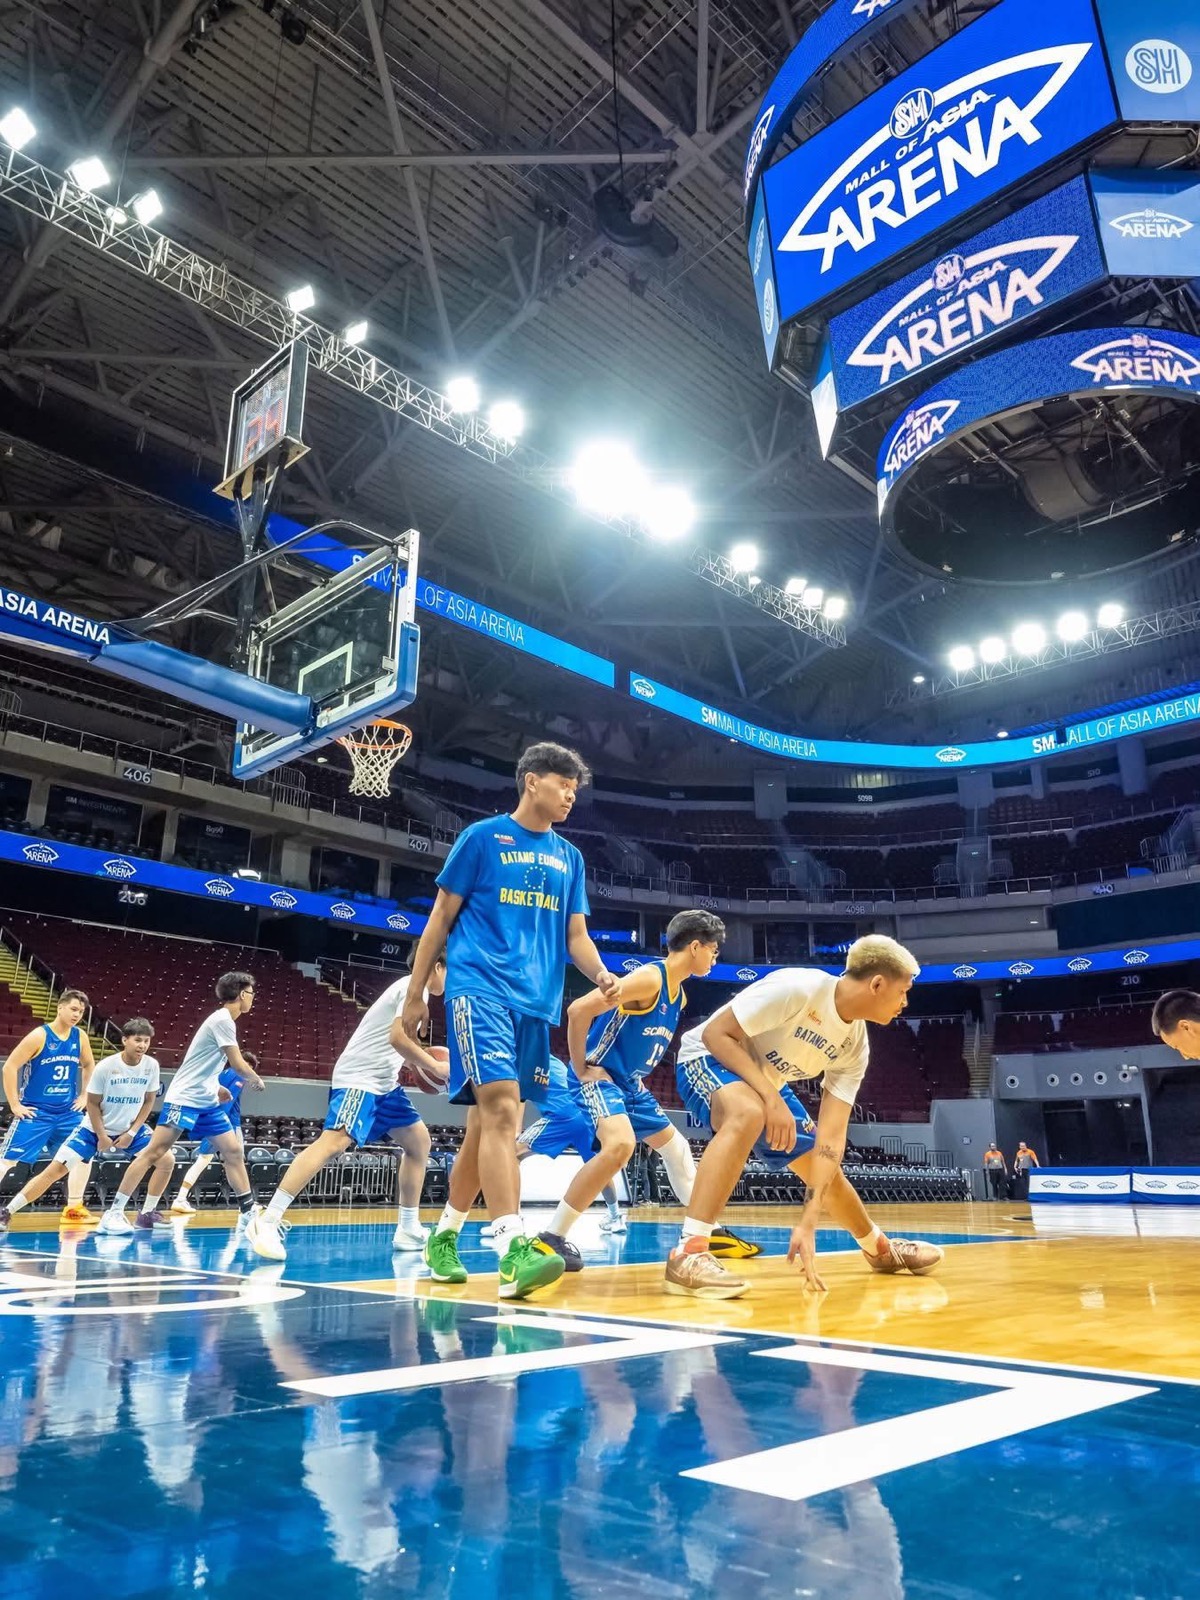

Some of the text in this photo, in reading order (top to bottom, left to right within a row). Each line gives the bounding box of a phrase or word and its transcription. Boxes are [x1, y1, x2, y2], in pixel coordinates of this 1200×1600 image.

[1134, 48, 1181, 84] SM
[892, 90, 932, 137] SM
[845, 89, 996, 194] MALL OF ASIA
[820, 96, 1043, 274] ARENA
[1121, 223, 1181, 238] ARENA
[934, 255, 963, 291] SM
[899, 260, 1009, 328] MALL OF ASIA
[879, 268, 1044, 385] ARENA
[1093, 357, 1191, 385] ARENA
[890, 415, 945, 480] ARENA
[41, 607, 110, 645] ARENA
[424, 585, 445, 609] OF
[446, 596, 477, 626] ASIA
[479, 610, 525, 646] ARENA
[702, 706, 717, 727] SM
[717, 714, 743, 739] MALL
[744, 724, 757, 742] OF
[759, 731, 781, 751] ASIA
[1032, 735, 1055, 754] SM
[1057, 727, 1095, 749] ALL
[1099, 719, 1115, 738] OF
[1119, 713, 1152, 733] ASIA
[124, 767, 151, 784] 406
[409, 838, 428, 851] 407
[26, 851, 52, 864] ARENA
[500, 851, 568, 874] BATANG EUROPA
[106, 865, 131, 878] ARENA
[207, 885, 231, 897] ARENA
[272, 897, 294, 908] ARENA
[500, 887, 560, 911] BASKETBALL
[598, 886, 613, 897] 408
[332, 908, 351, 919] ARENA
[700, 899, 719, 909] 409A
[845, 905, 865, 914] 409B
[381, 943, 400, 954] 207
[1126, 955, 1147, 964] ARENA
[1121, 975, 1140, 985] 210
[794, 1026, 827, 1049] BATANG
[53, 1065, 70, 1081] 31
